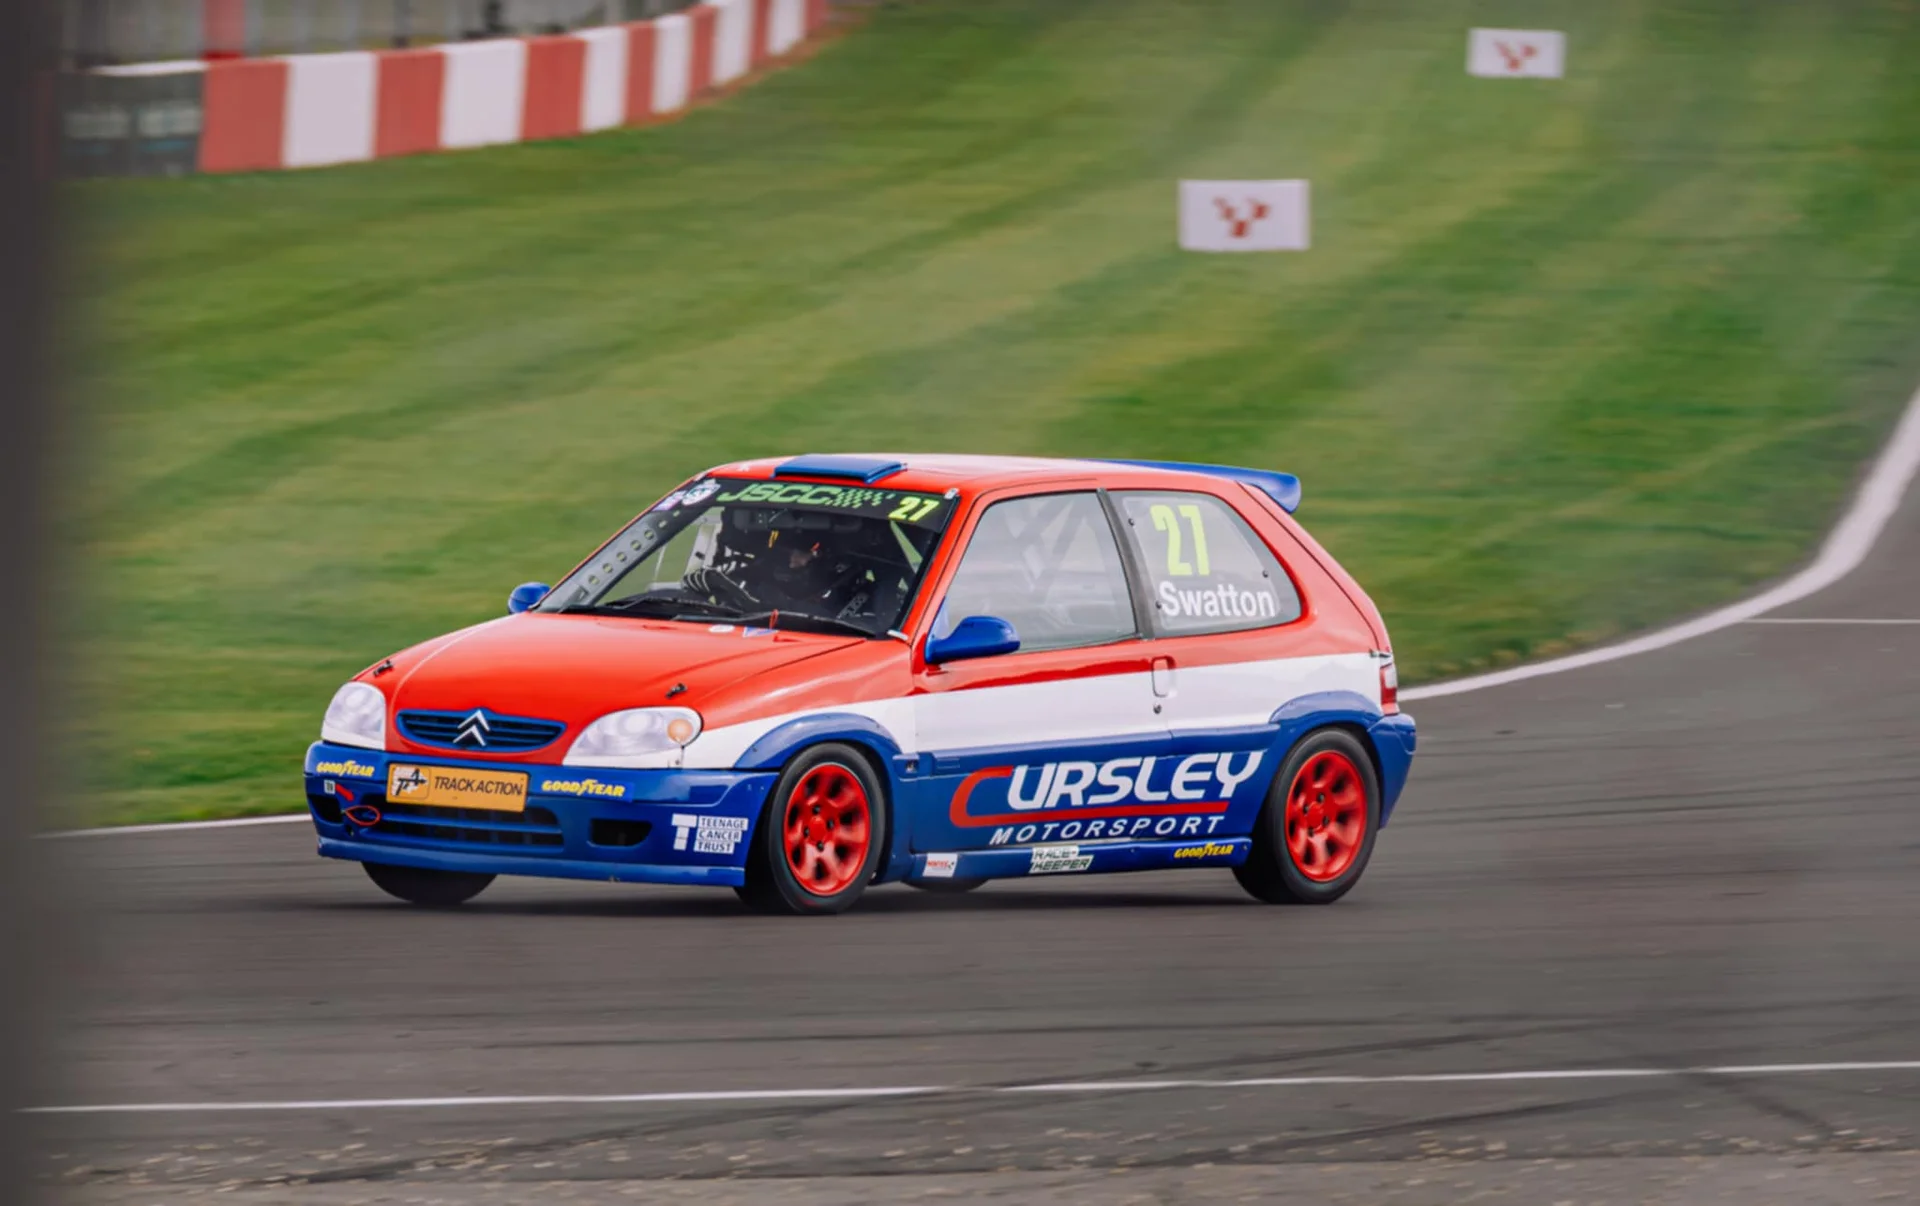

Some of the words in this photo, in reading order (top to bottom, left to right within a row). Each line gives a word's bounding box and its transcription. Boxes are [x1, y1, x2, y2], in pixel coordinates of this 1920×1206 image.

[717, 484, 836, 504] JSCC
[888, 496, 940, 522] 27
[1150, 504, 1211, 576] 27
[1159, 581, 1275, 617] Swatton
[541, 779, 626, 797] GOODYEAR
[949, 751, 1264, 828] CURSLEY
[701, 818, 745, 829] TEENAGE
[988, 815, 1225, 845] MOTORSPORT
[699, 829, 740, 841] CANCER
[698, 841, 731, 852] TRUST
[1174, 843, 1234, 859] GOODYEAR
[1033, 859, 1090, 870] KEEPER
